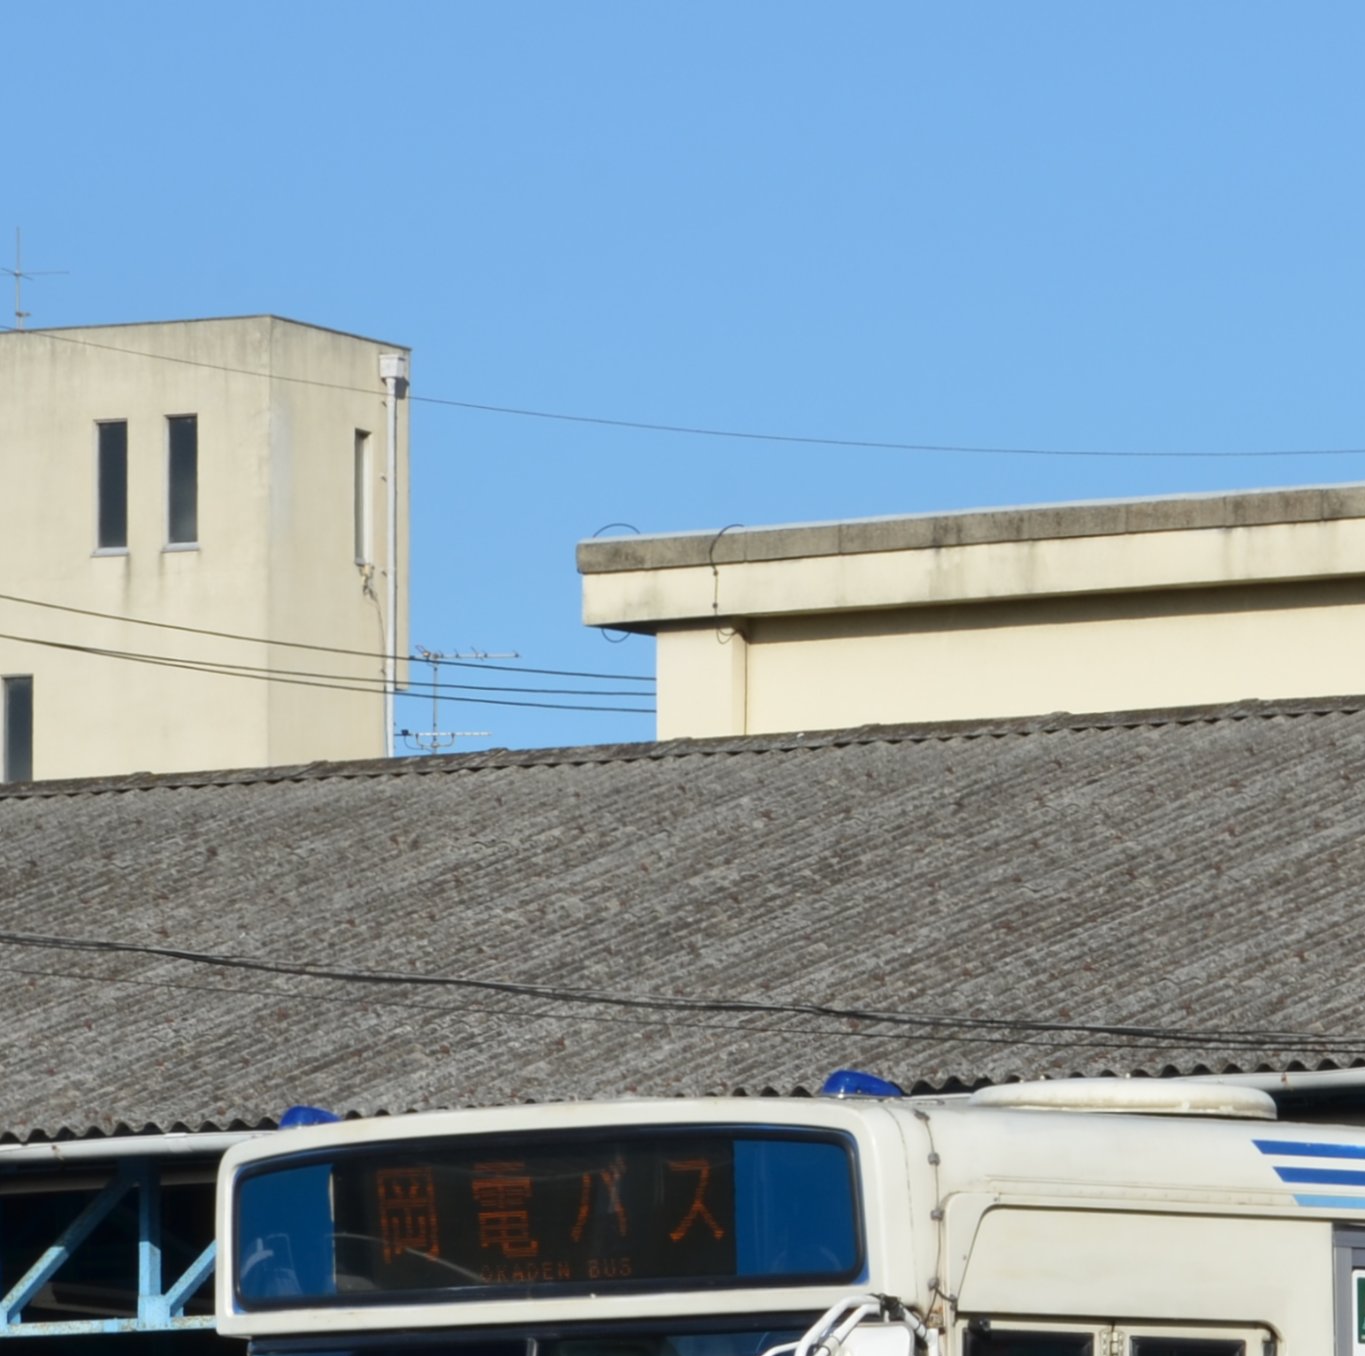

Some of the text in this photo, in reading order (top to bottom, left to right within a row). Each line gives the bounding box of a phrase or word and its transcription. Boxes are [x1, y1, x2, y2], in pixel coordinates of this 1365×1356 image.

[376, 1155, 725, 1264] 岡電バス
[588, 1256, 634, 1280] BUS
